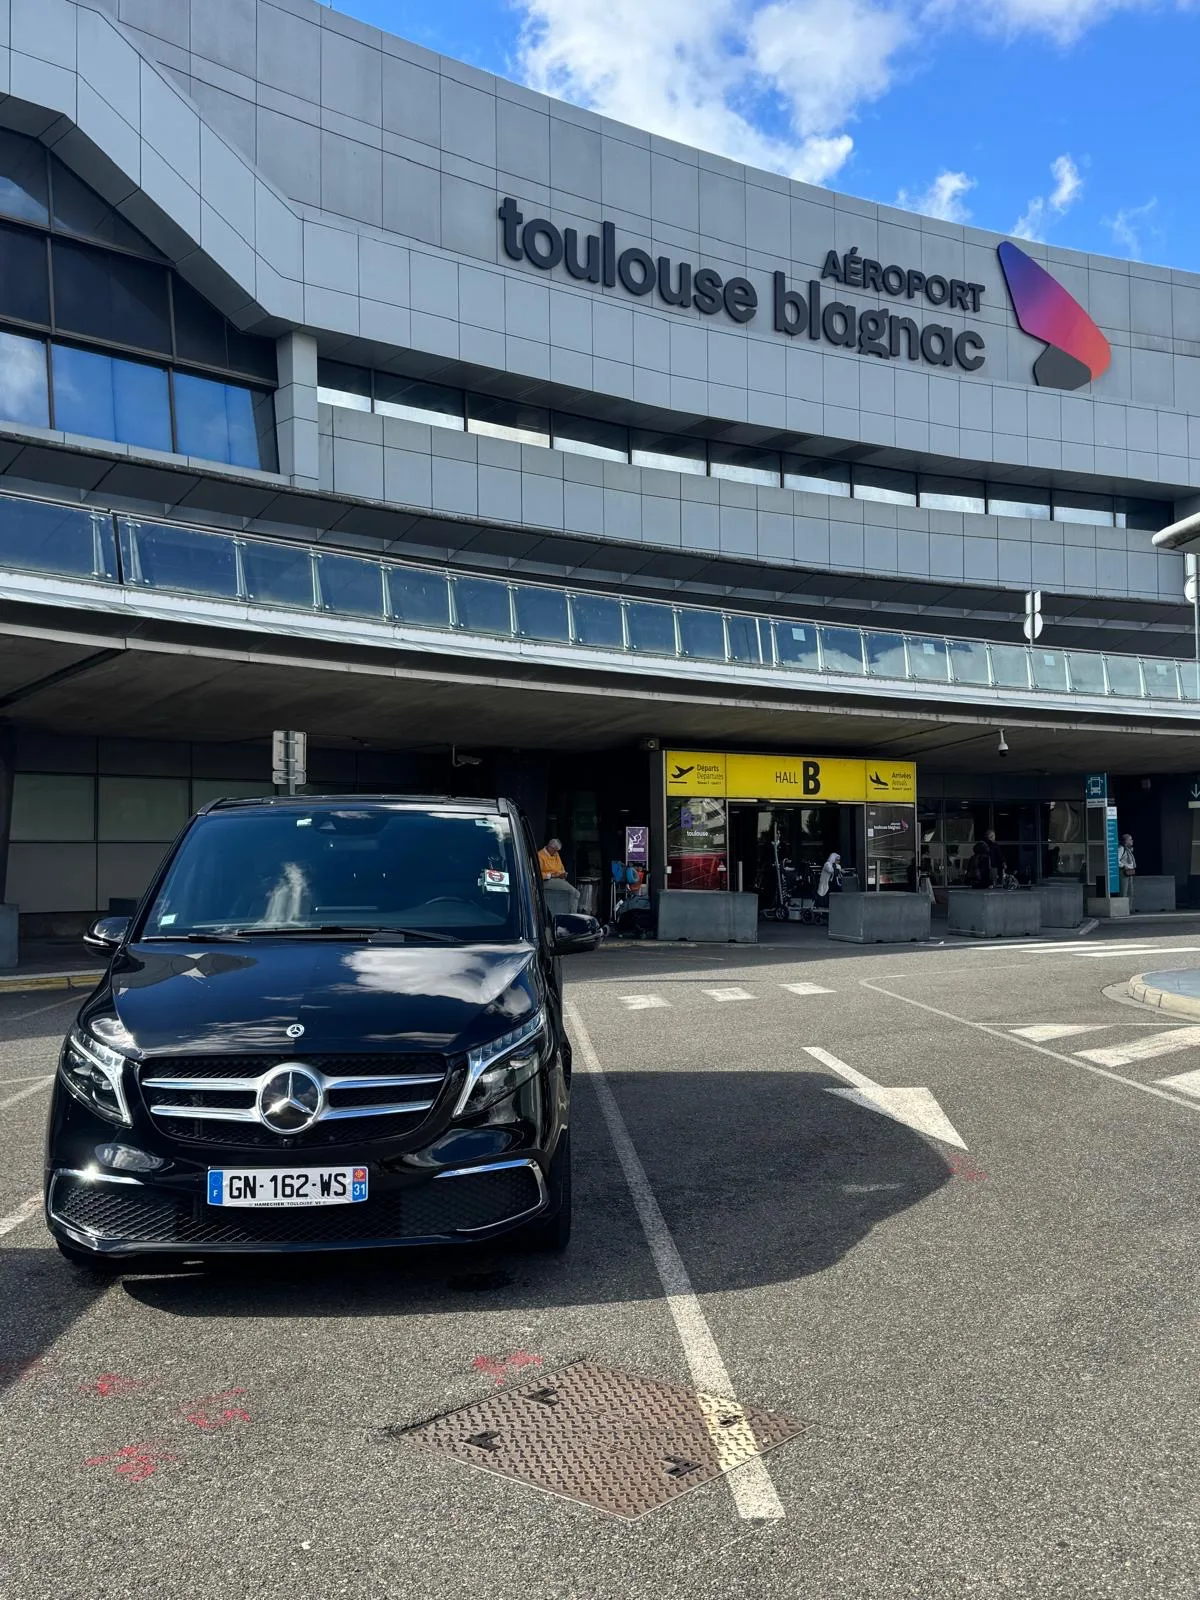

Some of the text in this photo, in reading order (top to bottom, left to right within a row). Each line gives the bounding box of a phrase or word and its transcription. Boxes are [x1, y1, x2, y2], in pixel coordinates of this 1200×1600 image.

[499, 197, 986, 371] toulouse blagnac
[822, 247, 985, 312] AÉROPORT
[696, 764, 720, 773] Départs
[775, 761, 821, 795] HALL B
[229, 1173, 347, 1199] GN-162-WS
[353, 1183, 366, 1196] 31
